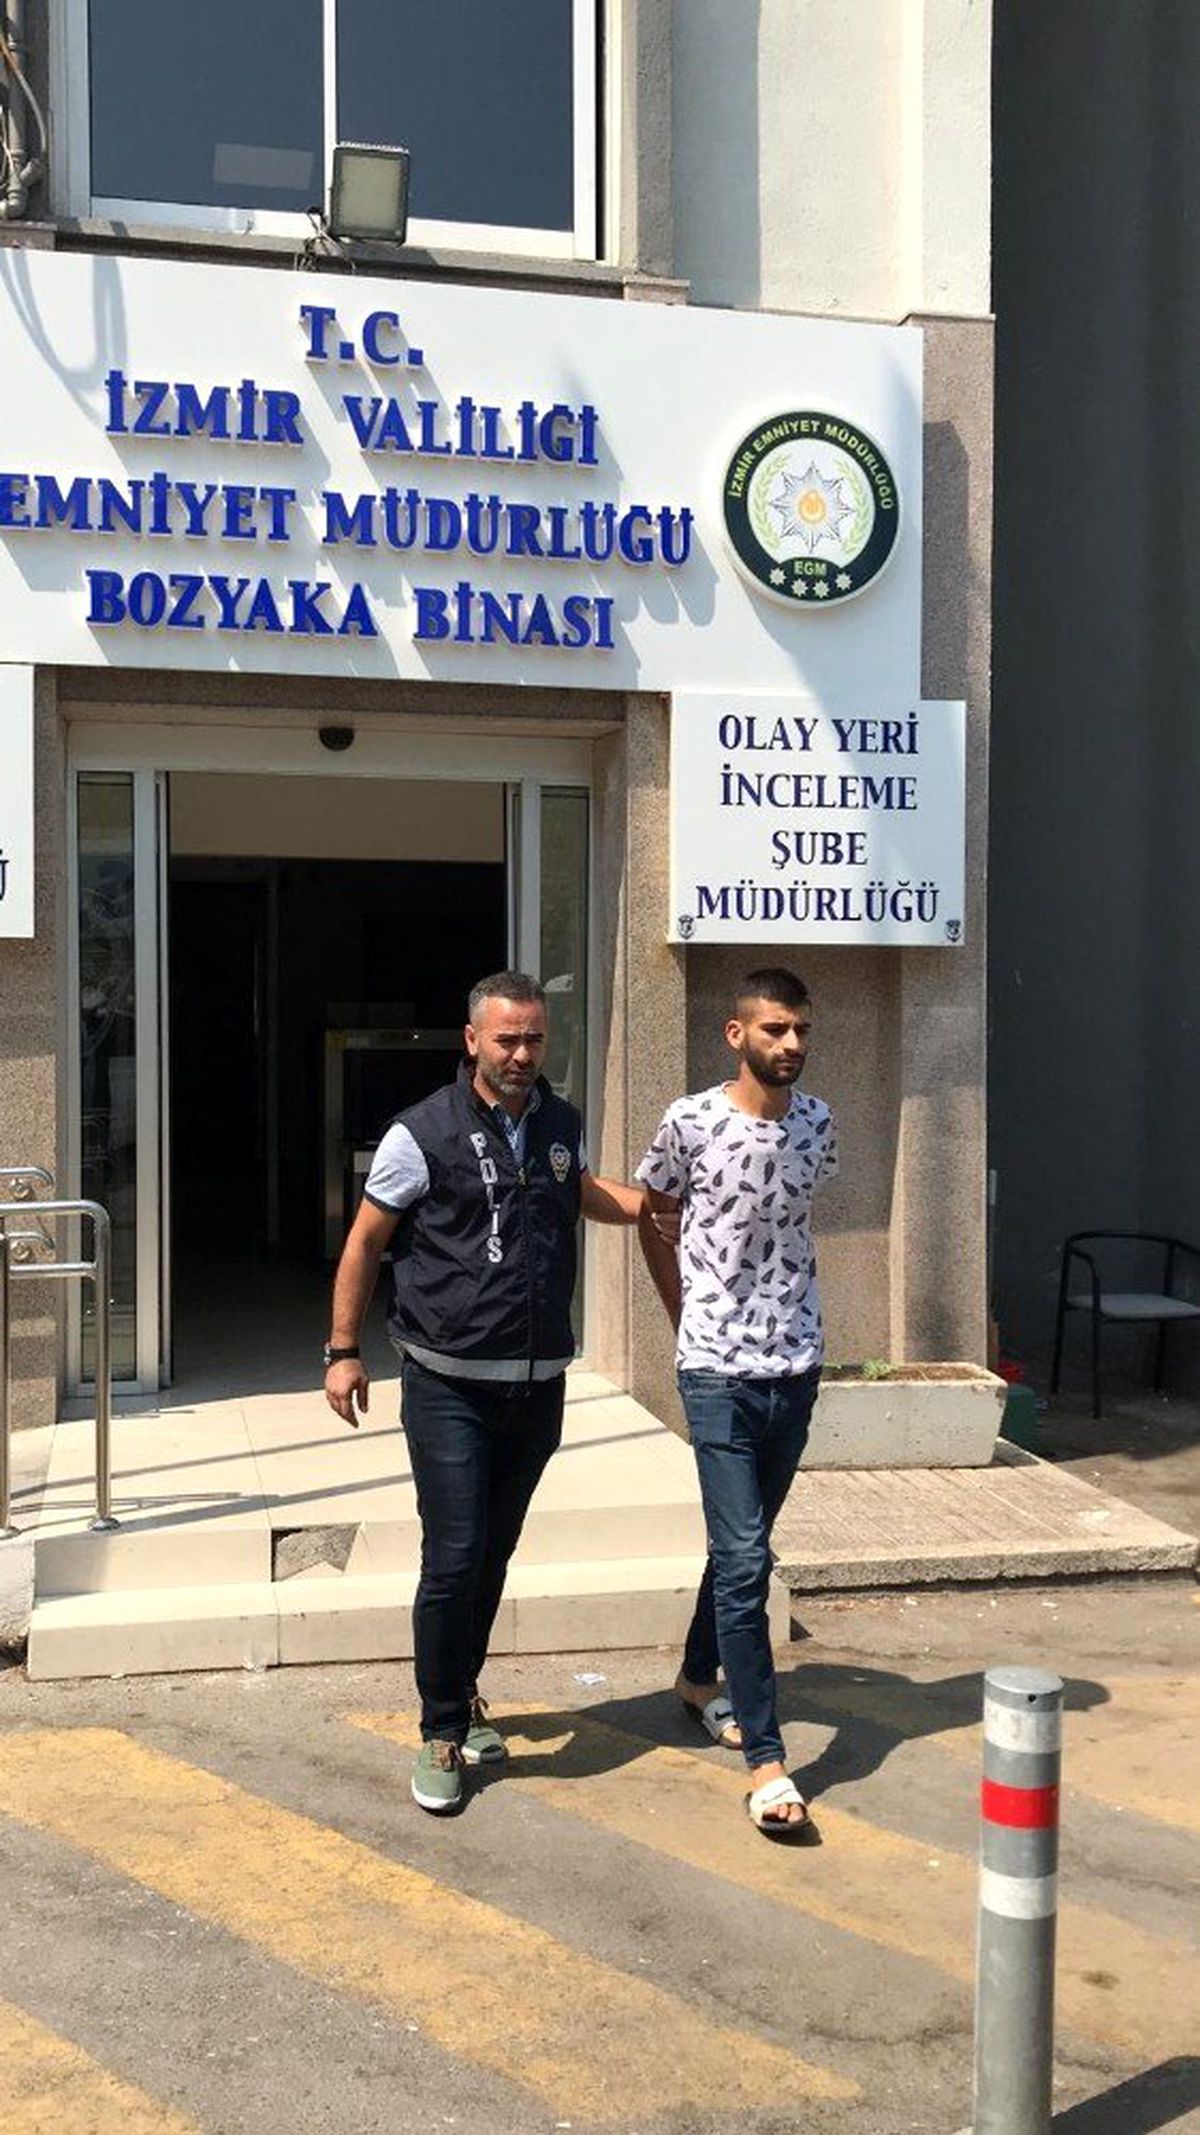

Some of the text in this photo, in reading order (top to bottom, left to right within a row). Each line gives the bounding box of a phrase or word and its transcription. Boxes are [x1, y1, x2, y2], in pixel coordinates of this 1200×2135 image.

[300, 305, 424, 366] T.C.
[106, 370, 599, 465] İZMİR VALİLİĞİ
[728, 420, 893, 510] İZMİR EMNİYET MÜDÜRLÜĞÜ
[0, 472, 693, 565] EMNİYET MÜDÜRLÜĞÜ
[794, 561, 827, 577] EGM
[86, 570, 614, 649] BOZYAKA BİNASI
[719, 711, 919, 755] OLAY YERİ
[720, 763, 917, 811] İNCELEME
[771, 830, 868, 870] ŞUBE
[696, 880, 939, 923] MÜDÜRLÜĞÜ
